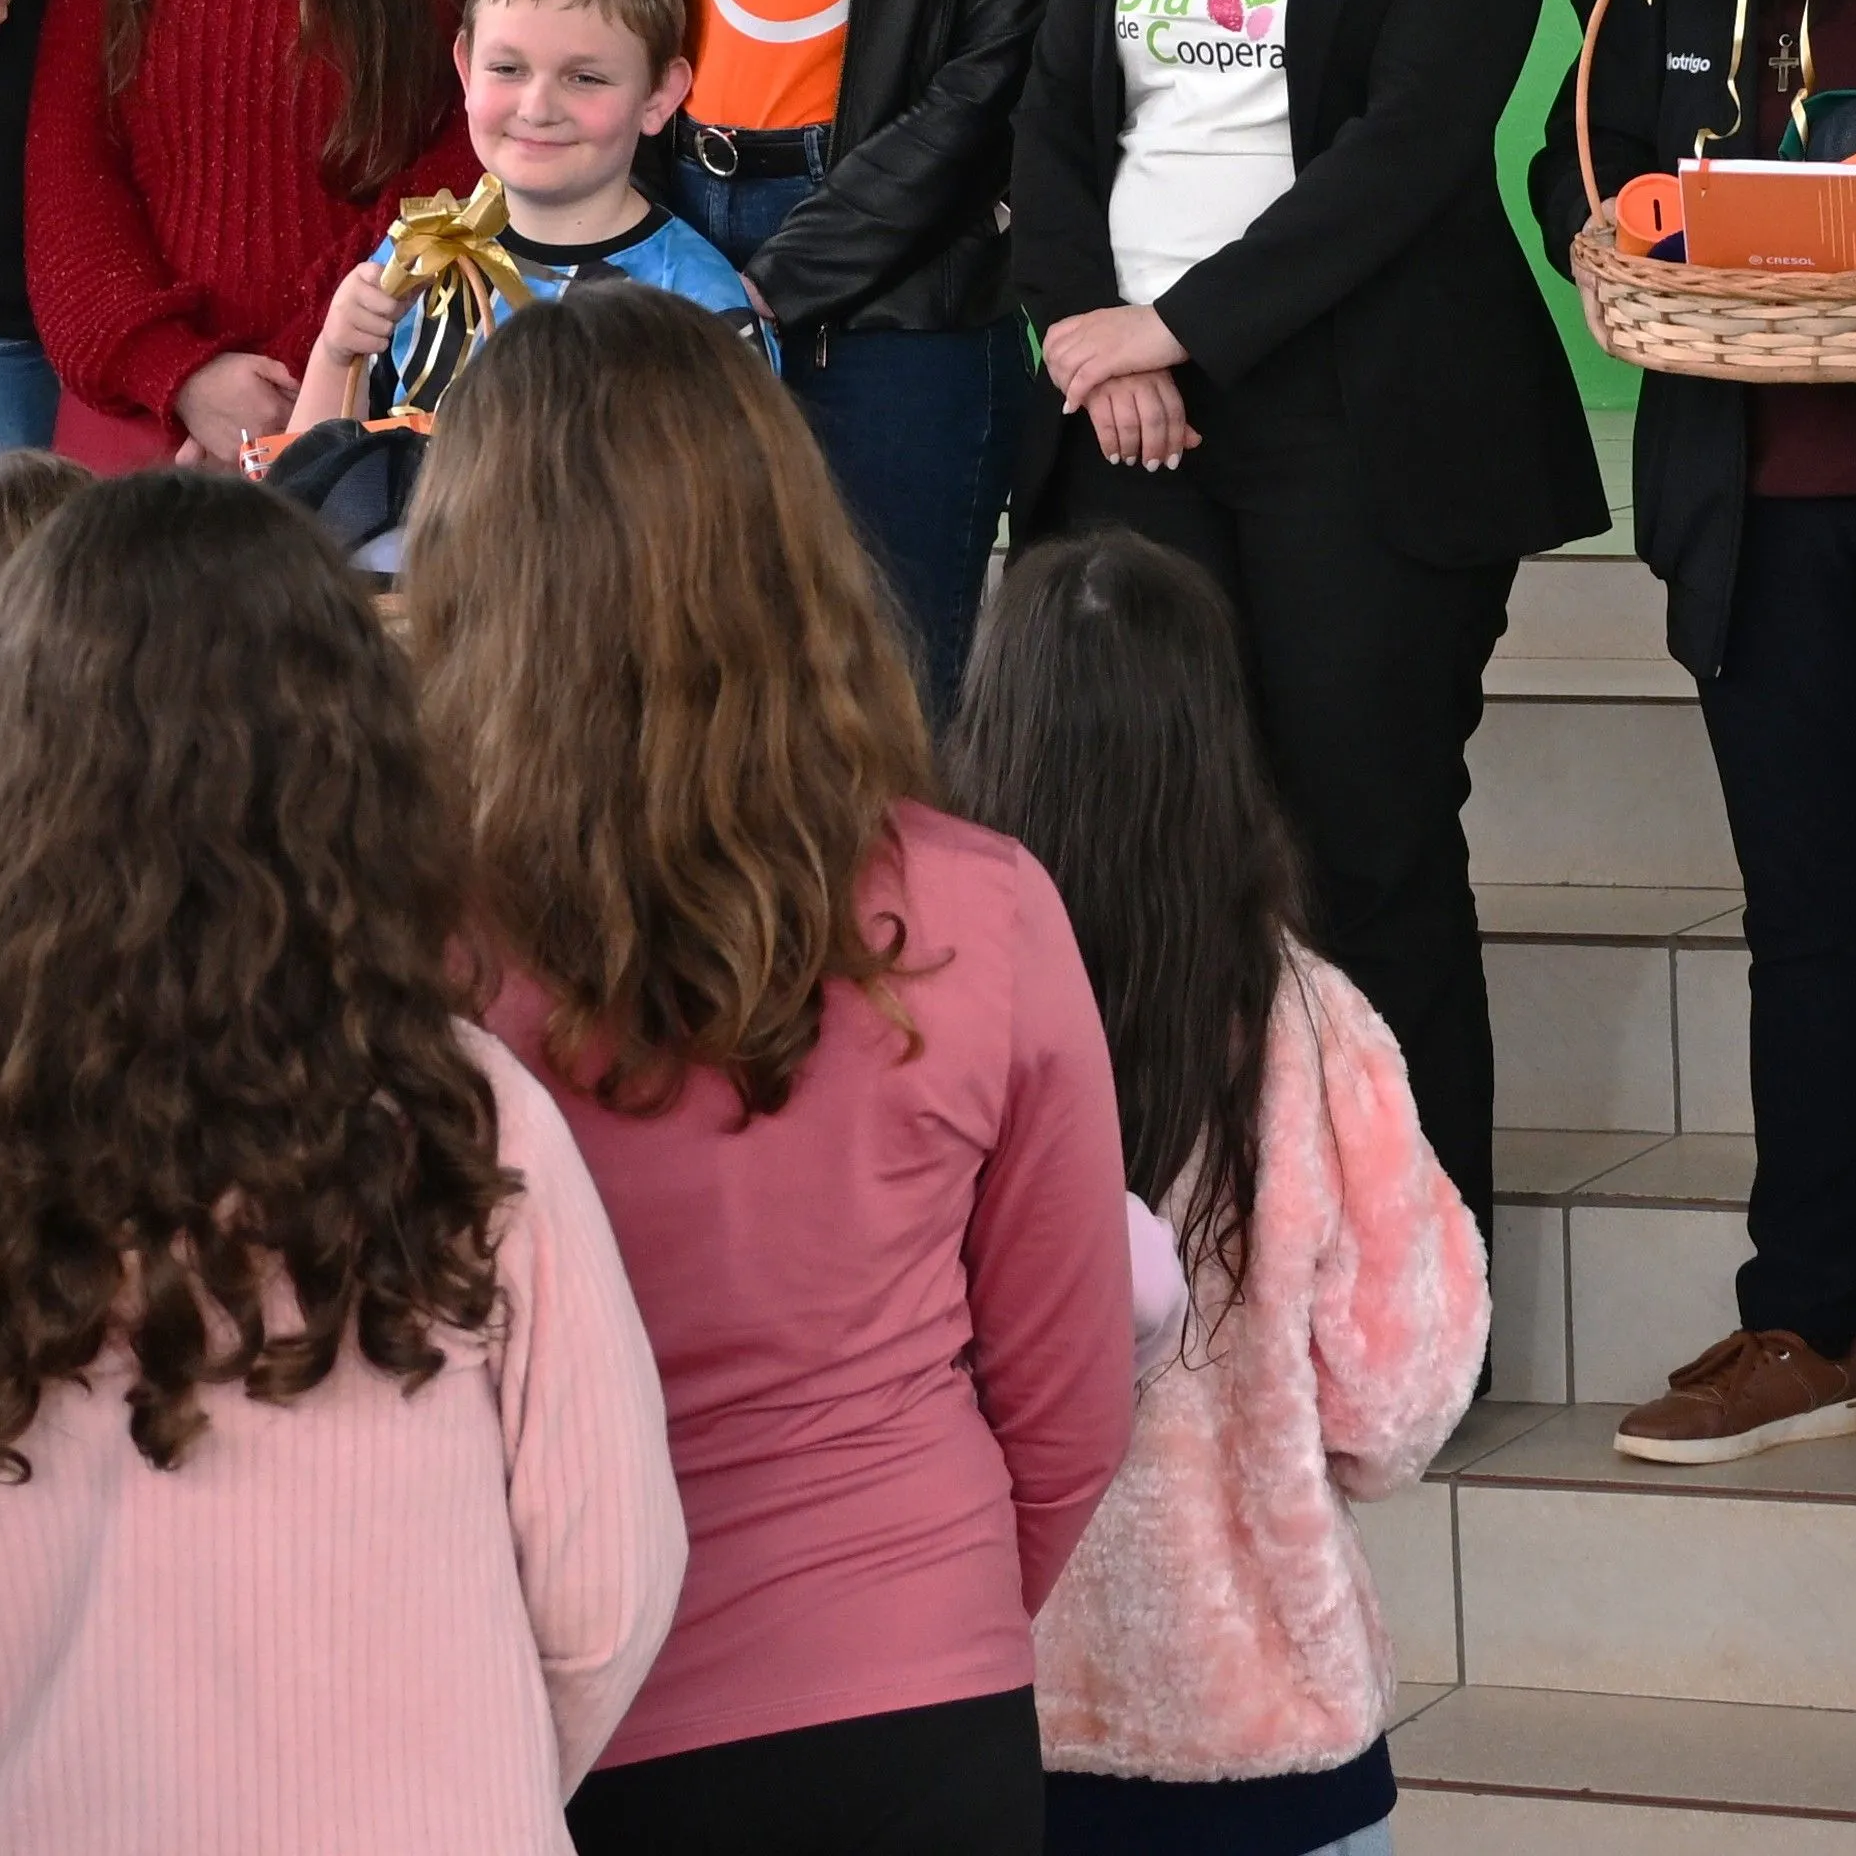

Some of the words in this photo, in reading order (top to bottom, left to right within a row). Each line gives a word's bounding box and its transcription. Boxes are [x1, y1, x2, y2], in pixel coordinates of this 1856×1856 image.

[1117, 15, 1139, 40] de
[1146, 20, 1287, 74] Coopera
[1766, 256, 1816, 266] CRESOL
